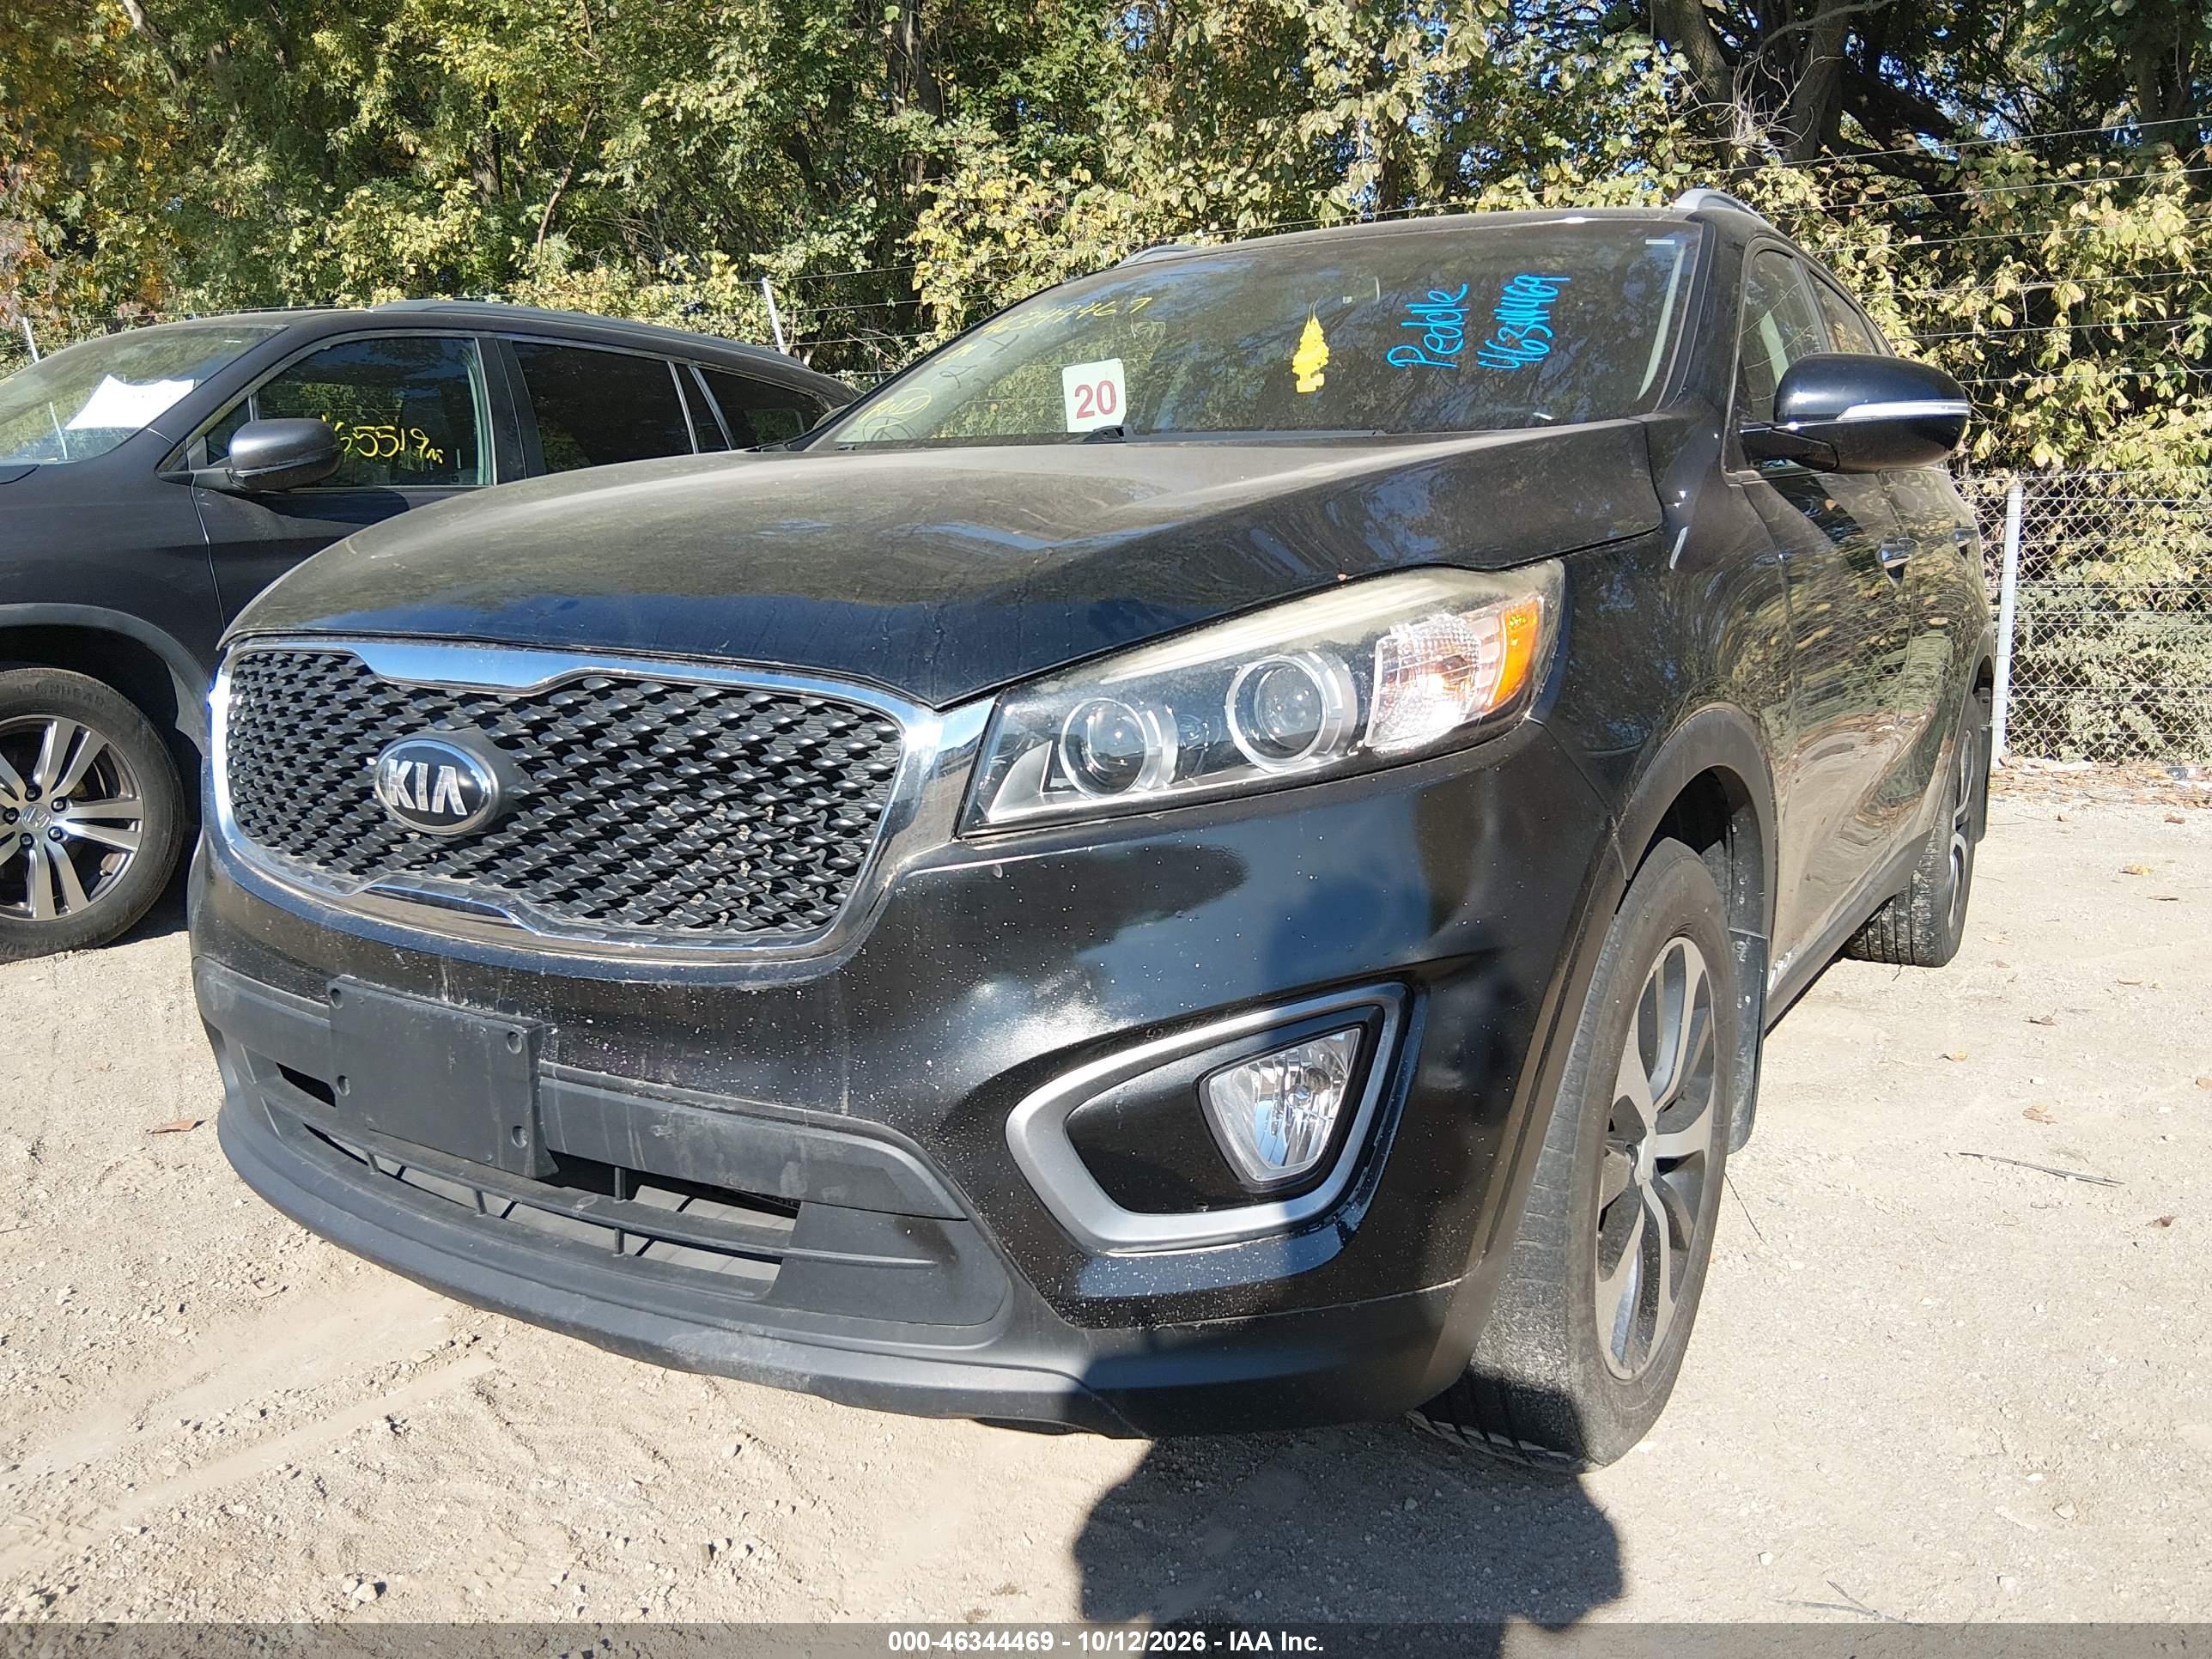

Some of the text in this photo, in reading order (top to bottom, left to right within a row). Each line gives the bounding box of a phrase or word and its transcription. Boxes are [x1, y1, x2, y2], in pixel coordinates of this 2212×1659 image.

[1386, 281, 1469, 369] Peddle
[1073, 379, 1117, 420] 20
[387, 758, 468, 816] KIA
